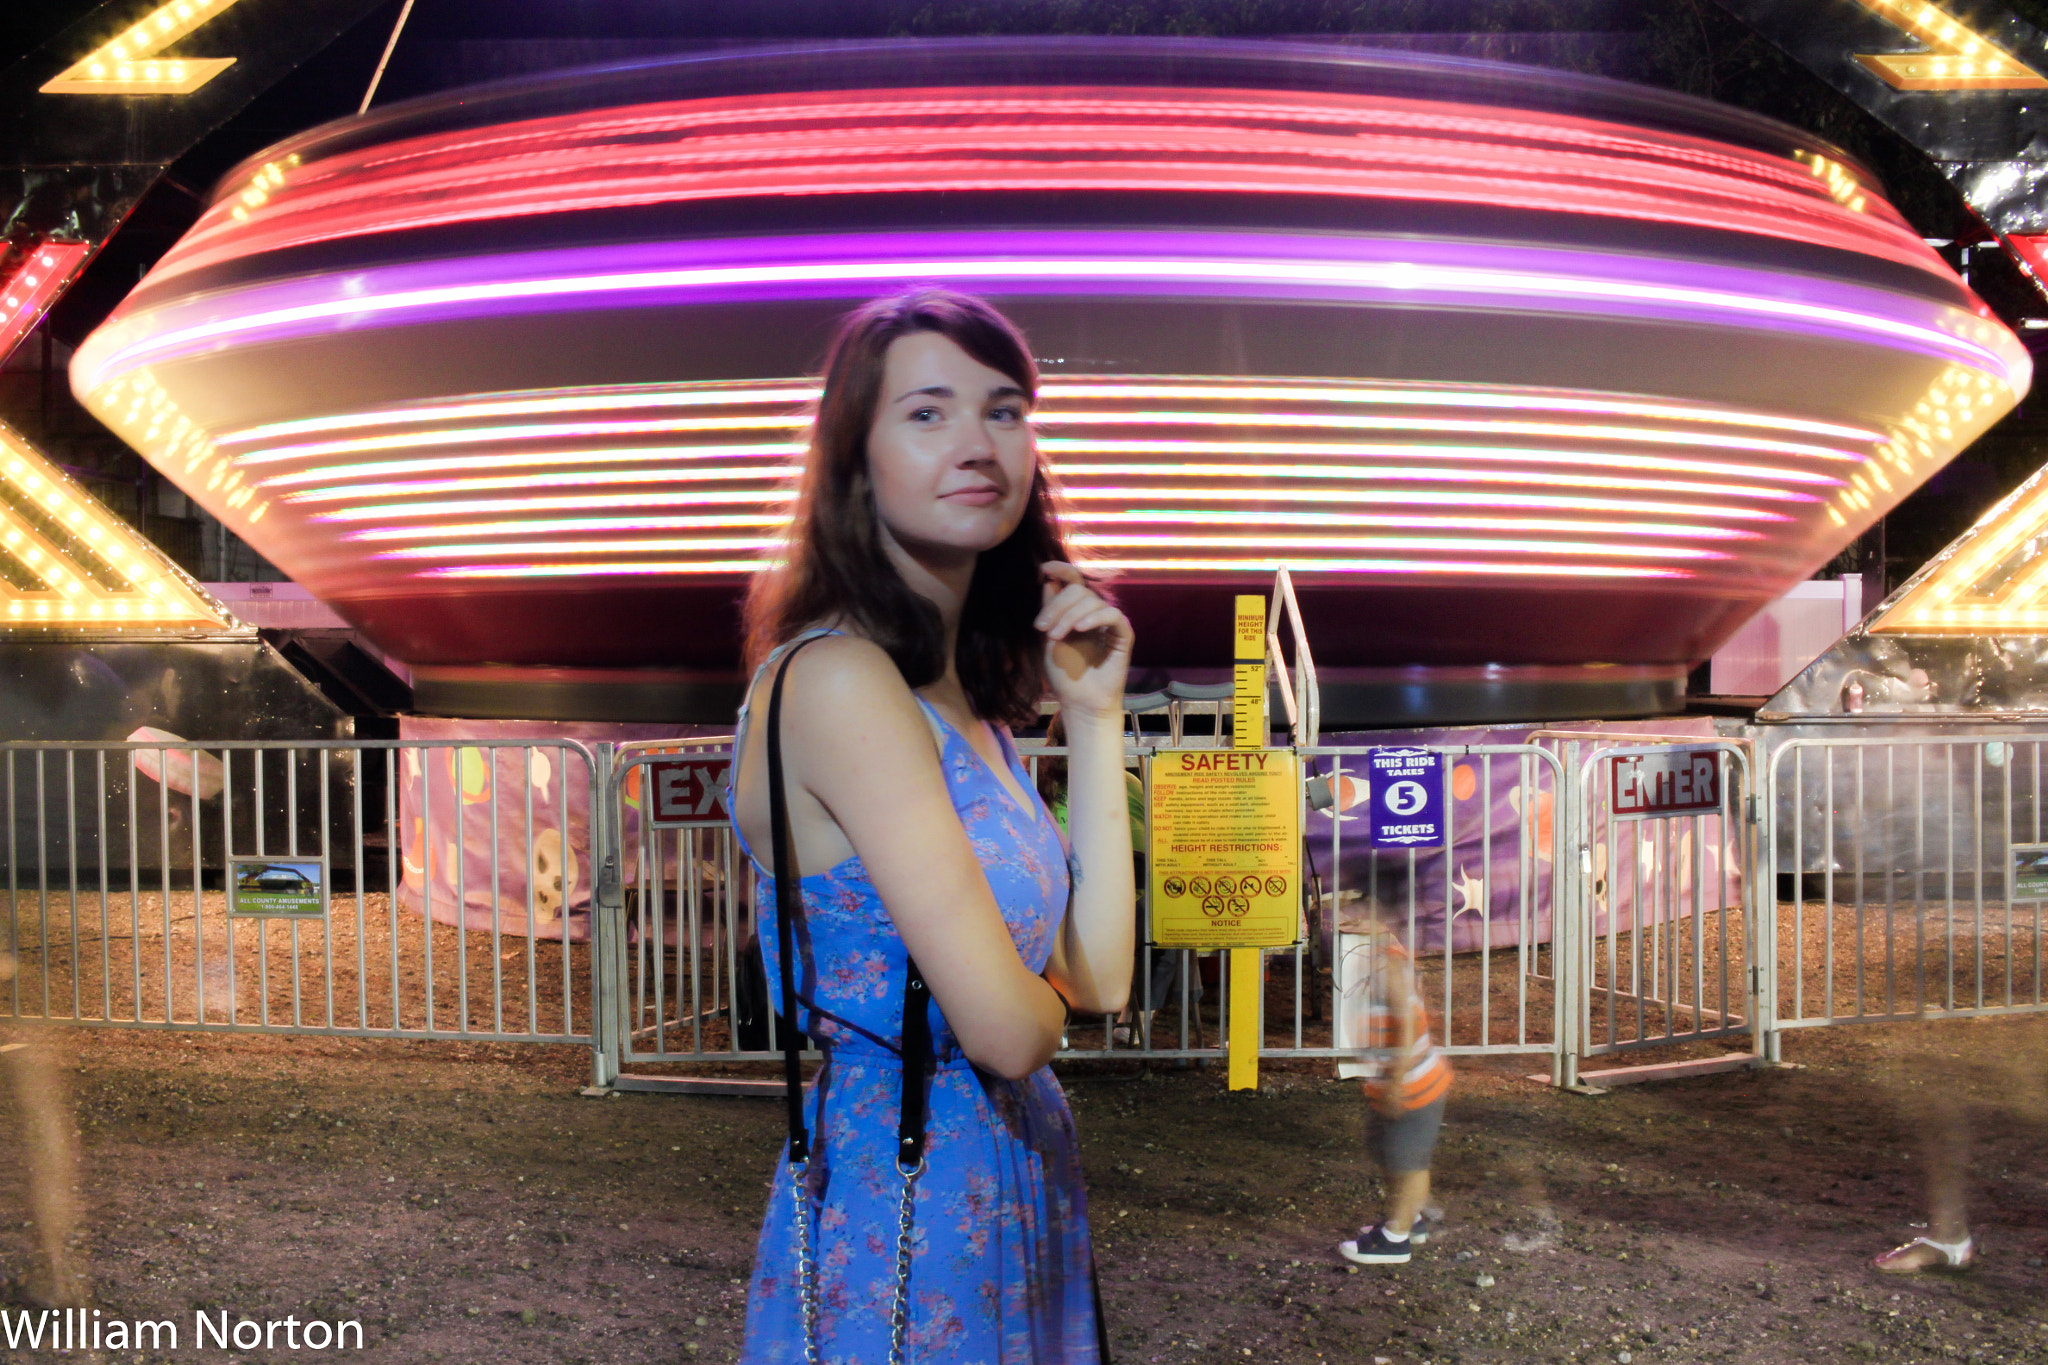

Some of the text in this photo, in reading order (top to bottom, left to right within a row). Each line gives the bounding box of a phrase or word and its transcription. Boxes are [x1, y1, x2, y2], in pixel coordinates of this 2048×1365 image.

[1181, 753, 1268, 771] SAFETY
[1374, 756, 1436, 768] THIS RIDE
[1386, 768, 1425, 776] TAKES
[1616, 758, 1714, 809] ENTER
[1396, 786, 1416, 810] 5
[1382, 824, 1435, 836] TICKETS
[1171, 843, 1283, 852] HEIGHT RESTRICTIONS:
